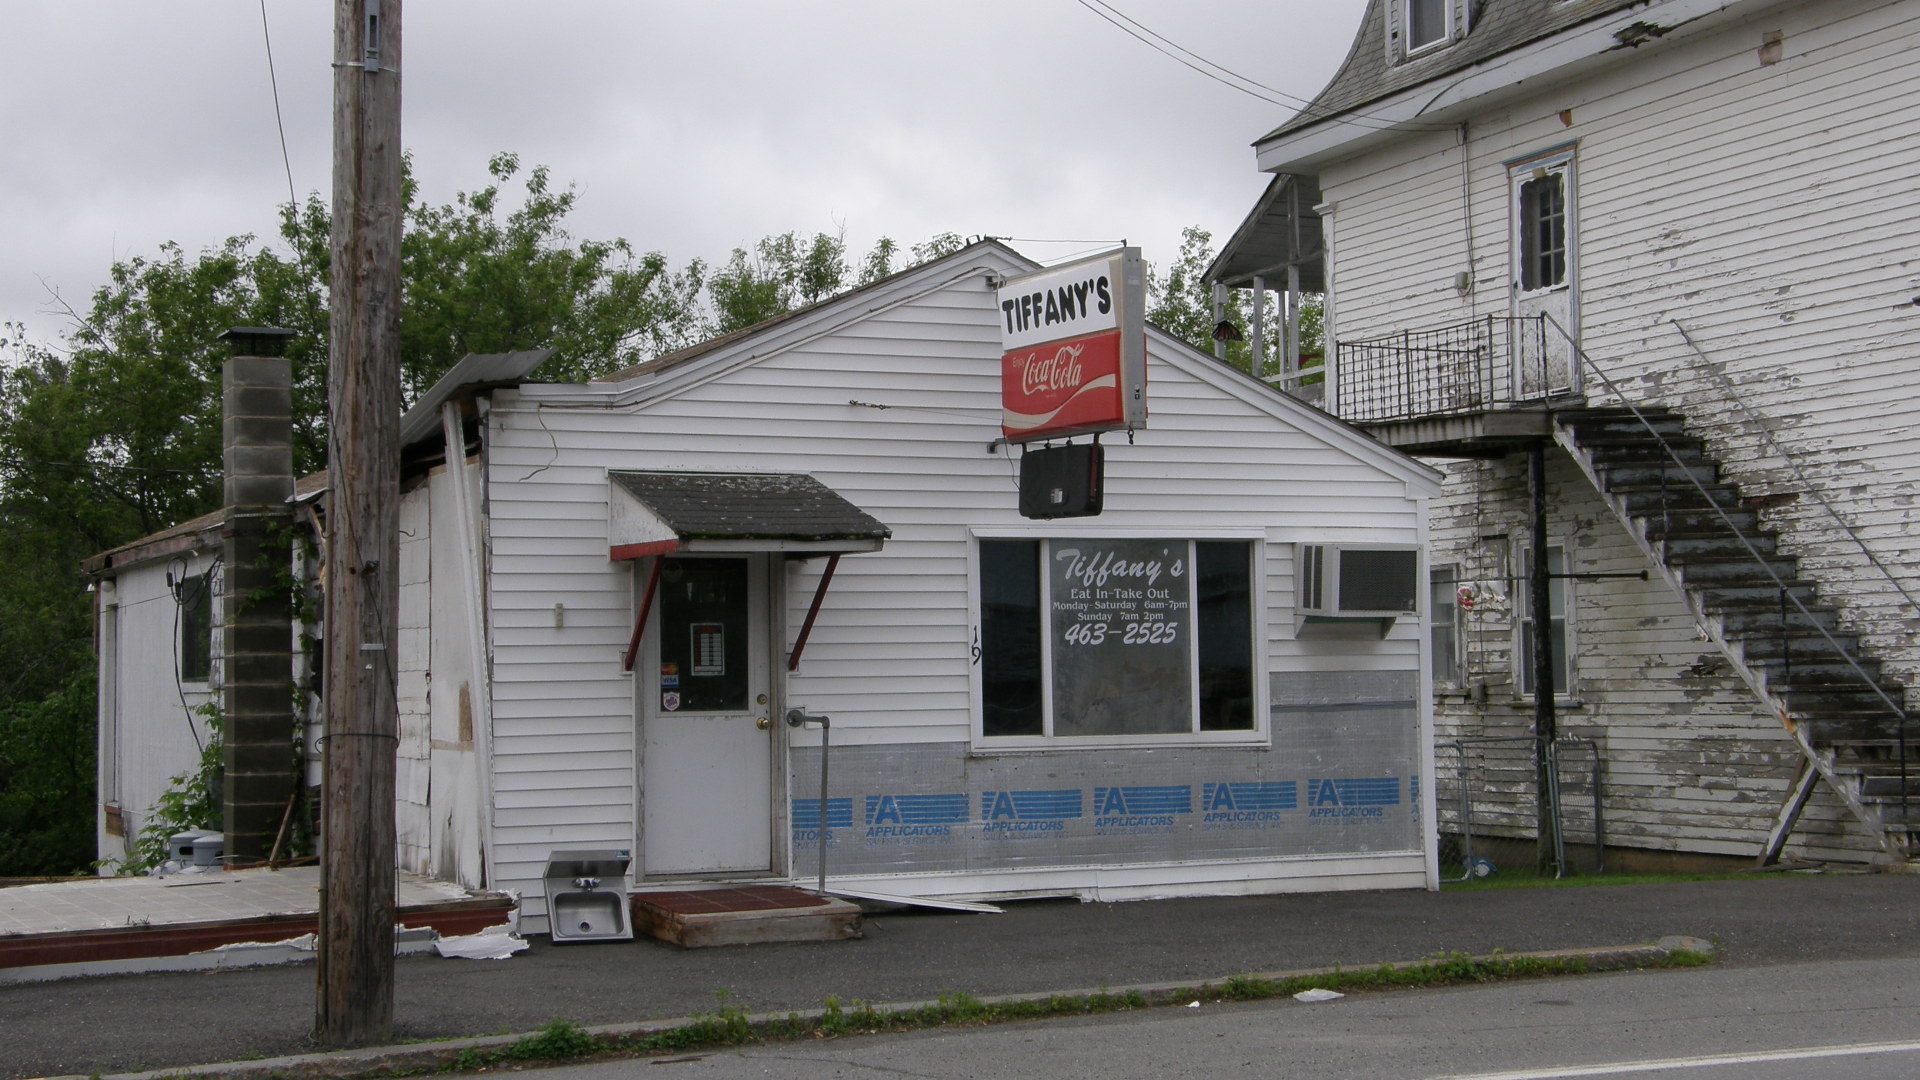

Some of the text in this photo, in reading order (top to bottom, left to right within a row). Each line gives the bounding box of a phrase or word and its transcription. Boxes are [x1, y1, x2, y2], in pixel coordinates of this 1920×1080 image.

[1002, 275, 1111, 335] TIFFANY'S
[1056, 548, 1184, 587] Tiffany's
[1070, 588, 1170, 599] Eat In-Take Out
[1144, 600, 1188, 611] 6am-7pm
[1077, 612, 1164, 622] Sunday 7am 2pm
[1065, 622, 1179, 646] 463-2525
[1203, 811, 1281, 823] APPLICATORS
[1308, 807, 1384, 818] APPLICATORS
[982, 820, 1064, 833] APPLICATORS
[1094, 815, 1174, 828] APPLICATORS
[865, 826, 951, 838] APPLICATORS
